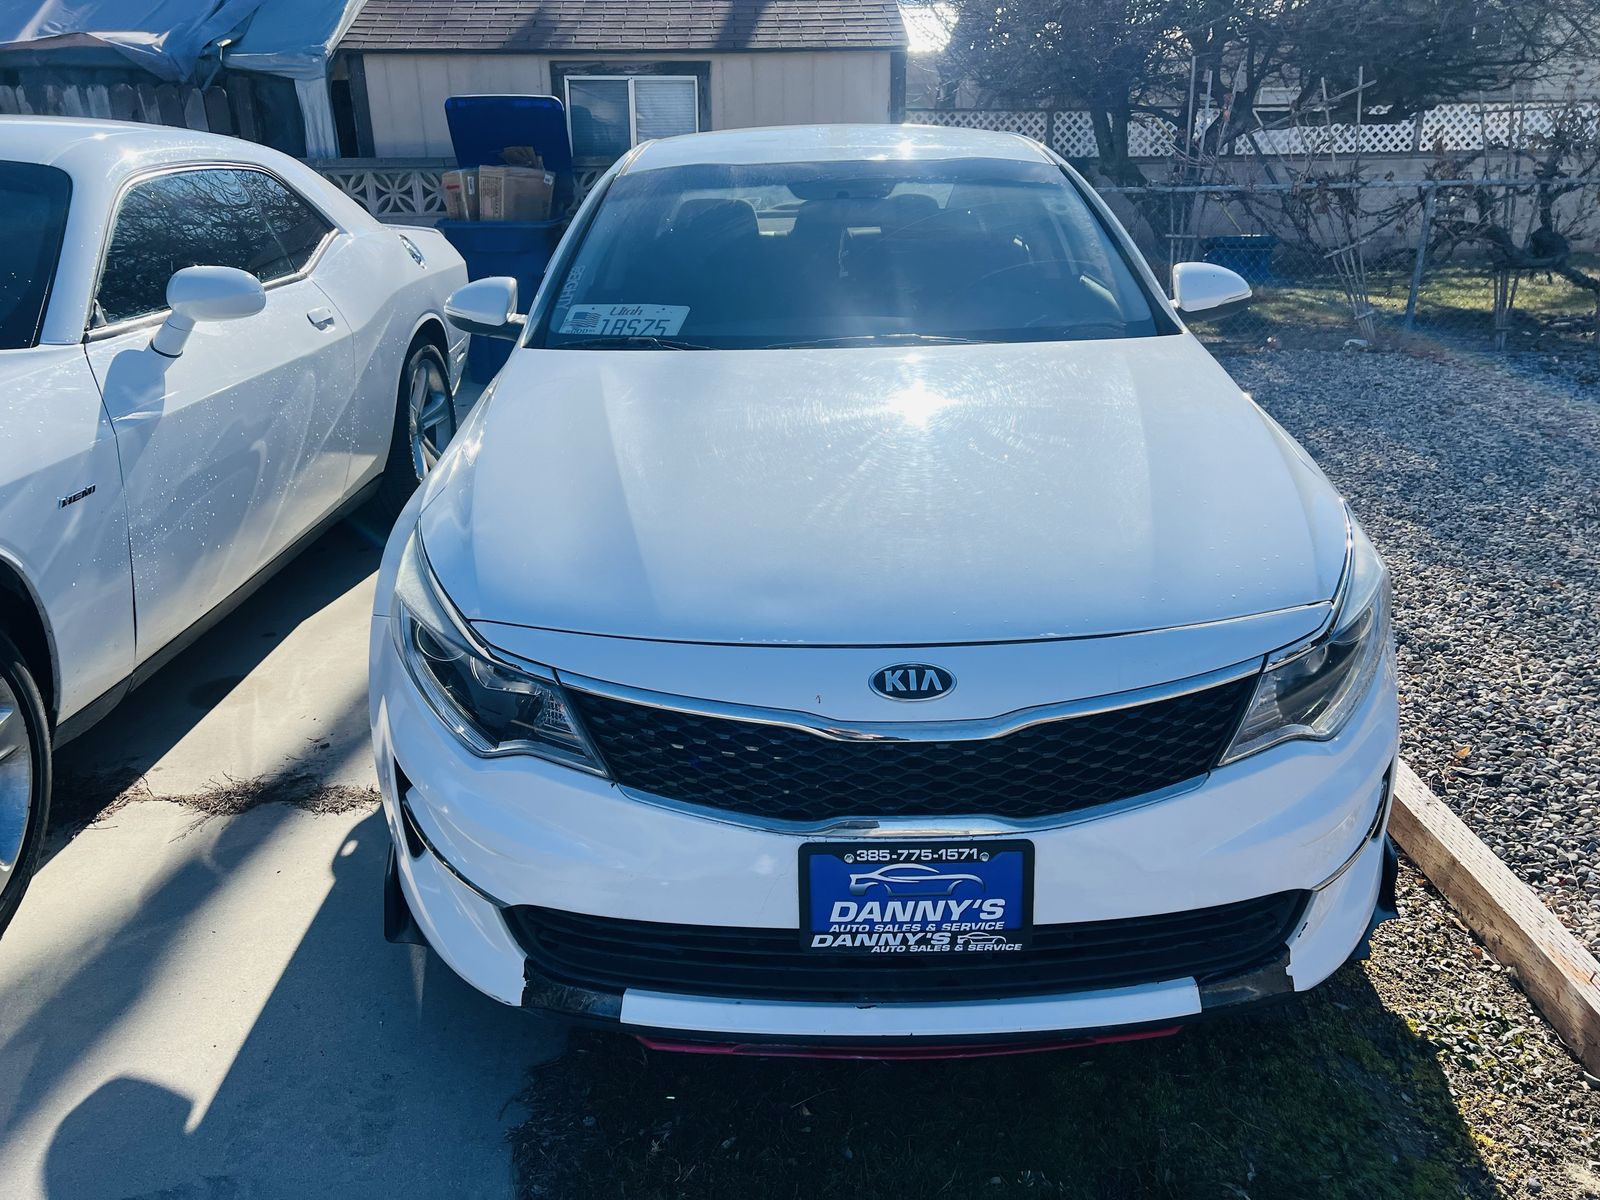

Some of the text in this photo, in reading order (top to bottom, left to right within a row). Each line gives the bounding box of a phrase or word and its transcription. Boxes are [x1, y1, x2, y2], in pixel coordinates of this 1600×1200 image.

[610, 306, 643, 316] Utah
[57, 484, 96, 510] HEMI
[884, 669, 943, 692] KIA
[856, 848, 978, 861] 385-775-1571
[829, 898, 1006, 923] DANNY'S
[829, 921, 1005, 933] AUTO SALES & SERVICE
[811, 932, 951, 948] DANNY'S
[871, 945, 906, 953] AUTO
[909, 944, 951, 952] SALES
[967, 943, 1023, 951] SERVICE
